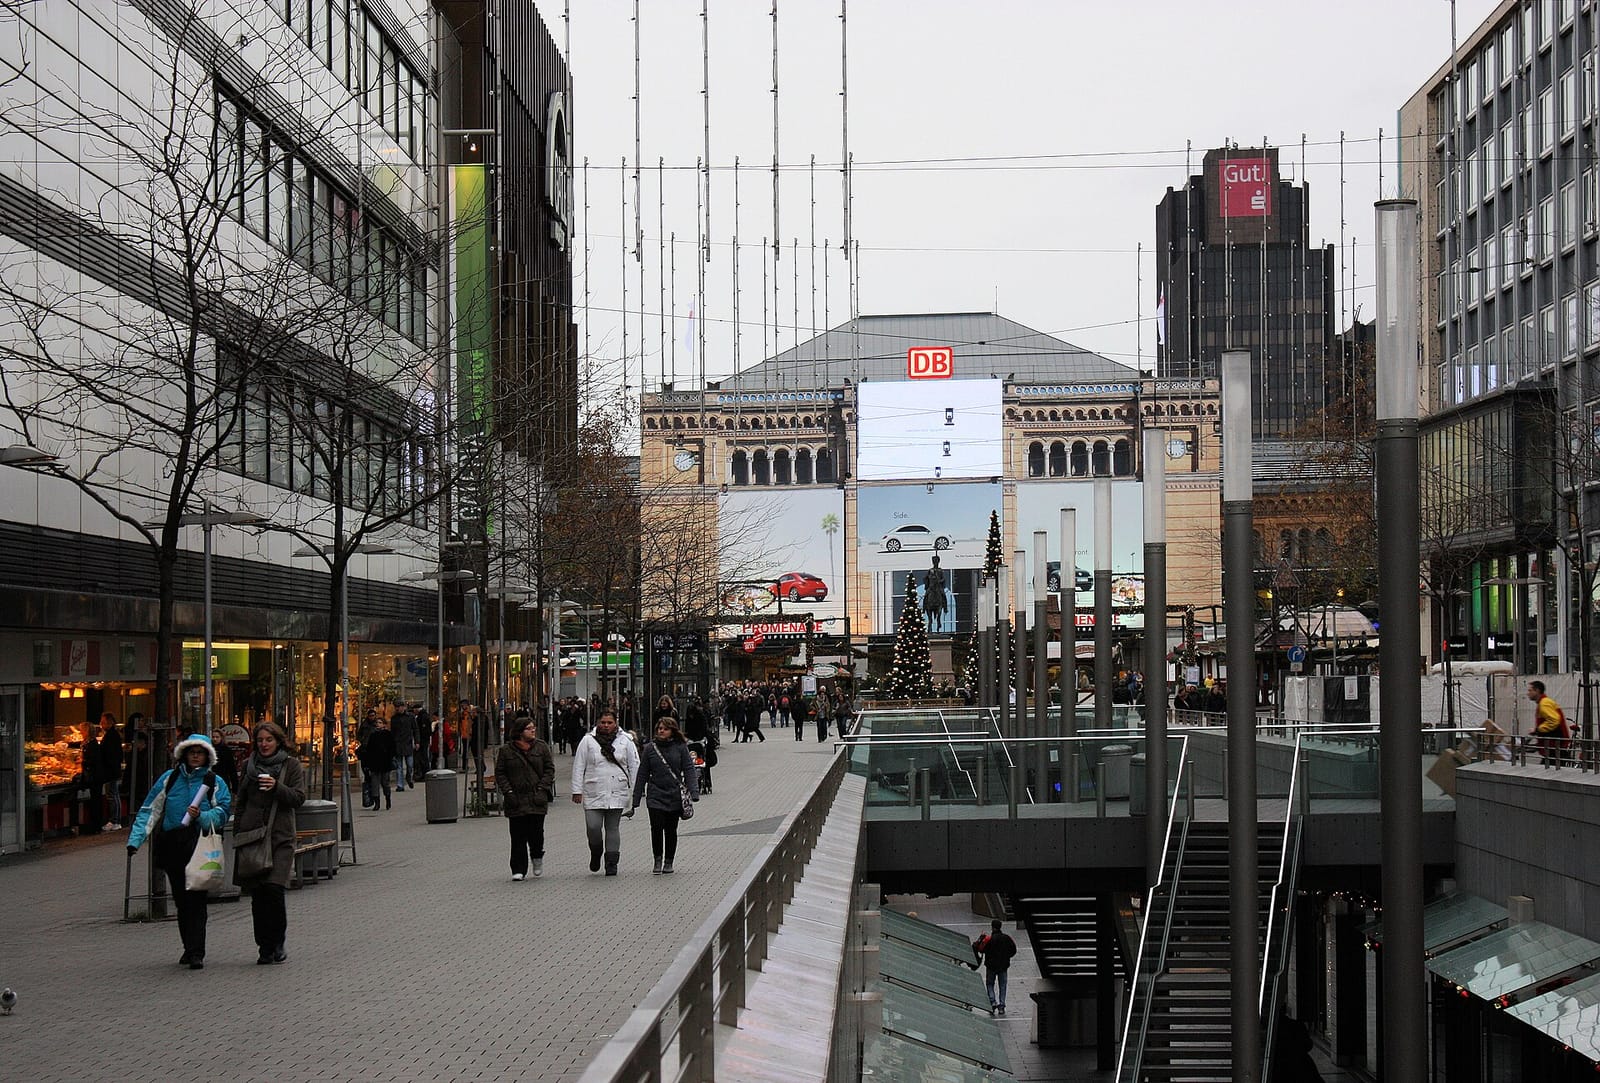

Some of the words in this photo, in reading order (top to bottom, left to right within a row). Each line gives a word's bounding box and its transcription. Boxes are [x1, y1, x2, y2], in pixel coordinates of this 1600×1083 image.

[1224, 164, 1265, 183] Gut.
[913, 351, 948, 374] DB
[742, 621, 824, 634] PROMENAE
